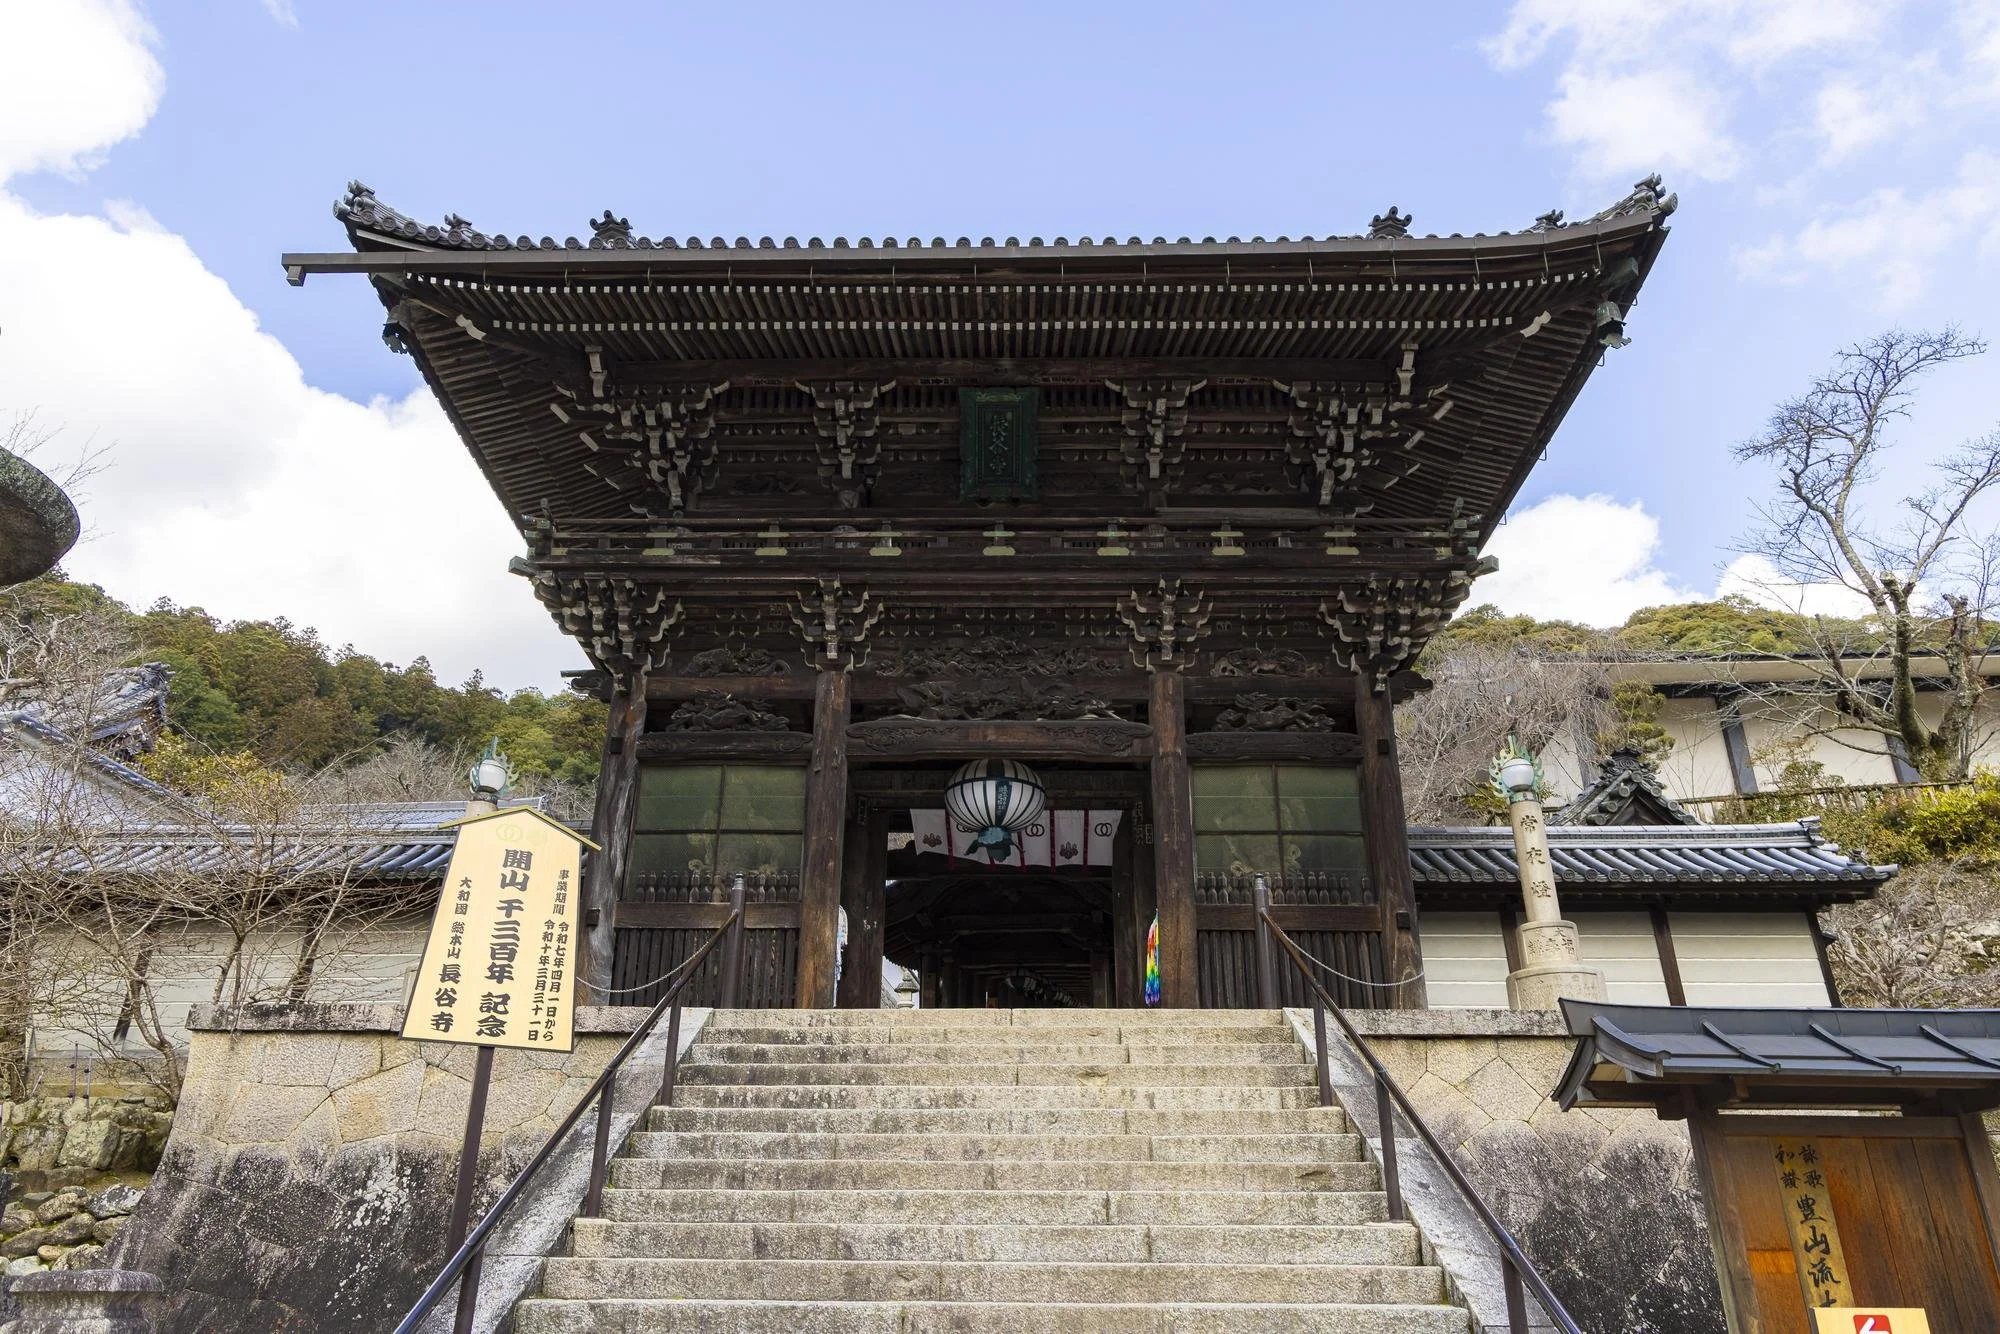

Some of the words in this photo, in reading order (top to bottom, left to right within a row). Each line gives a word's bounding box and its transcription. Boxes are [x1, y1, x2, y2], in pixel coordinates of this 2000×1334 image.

[552, 869, 570, 916] 事業期間
[528, 919, 556, 1042] 令和十年三月三十一日
[542, 921, 570, 1042] 令和七年四月一日から
